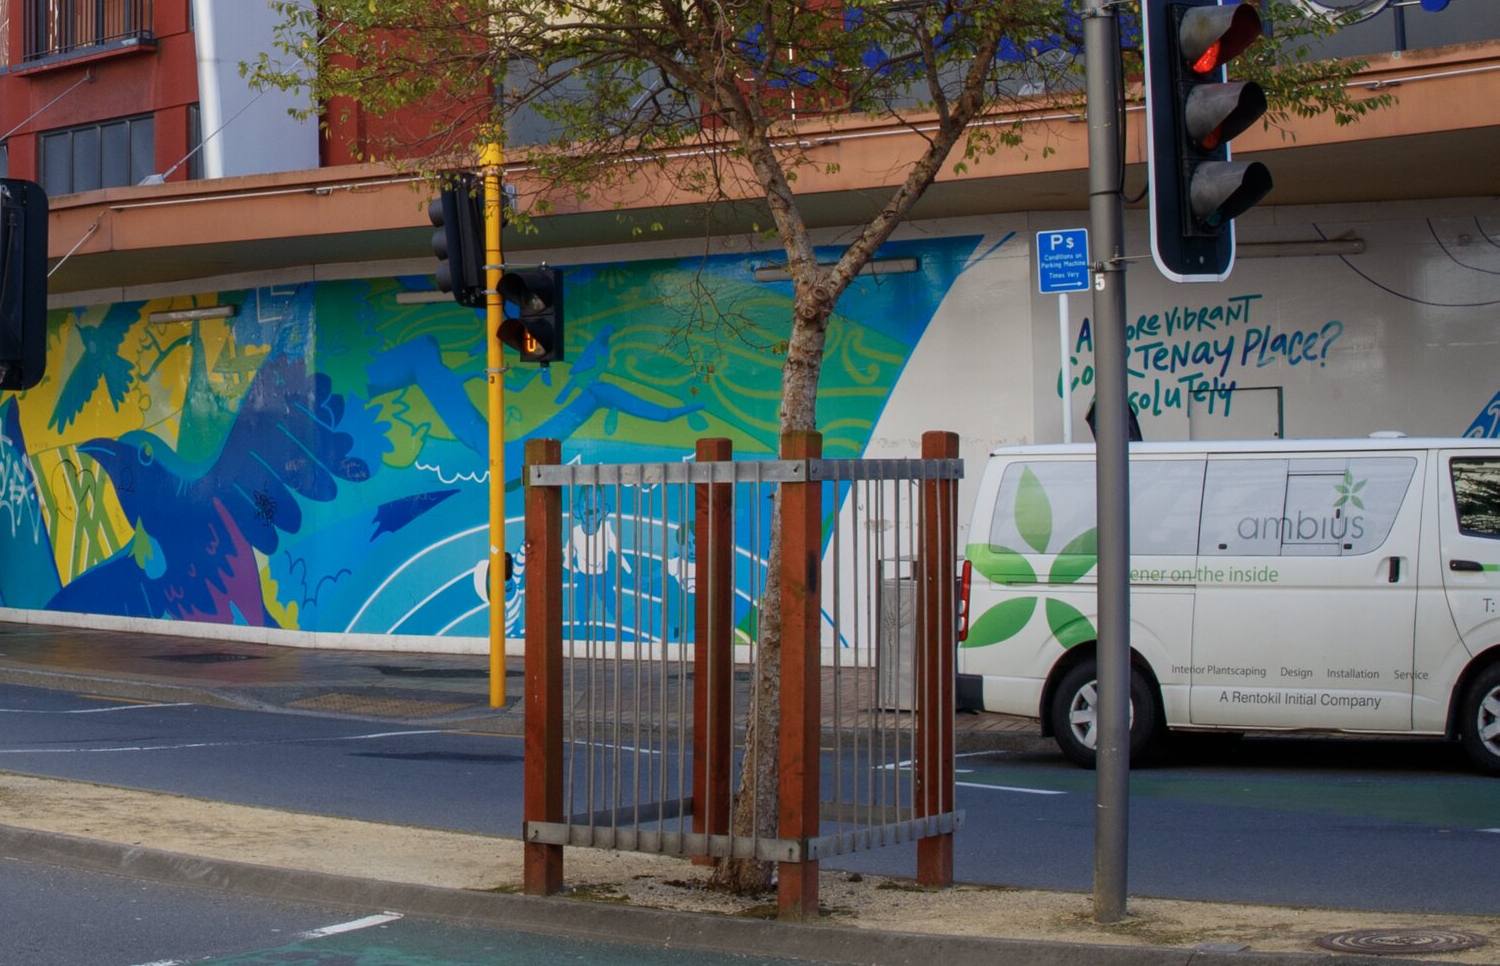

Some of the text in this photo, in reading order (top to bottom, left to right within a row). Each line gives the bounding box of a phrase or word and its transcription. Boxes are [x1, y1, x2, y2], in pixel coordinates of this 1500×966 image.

[1041, 262, 1062, 270] Parking
[1095, 273, 1106, 291] 5
[1076, 317, 1093, 353] A
[1237, 510, 1365, 540] ambius
[1171, 569, 1195, 583] on
[1196, 565, 1224, 583] the
[1229, 565, 1279, 584] inside
[1171, 664, 1429, 681] Interior Plantscaping Design Installation Service
[1219, 690, 1382, 710] A Rentokil Initial Company
